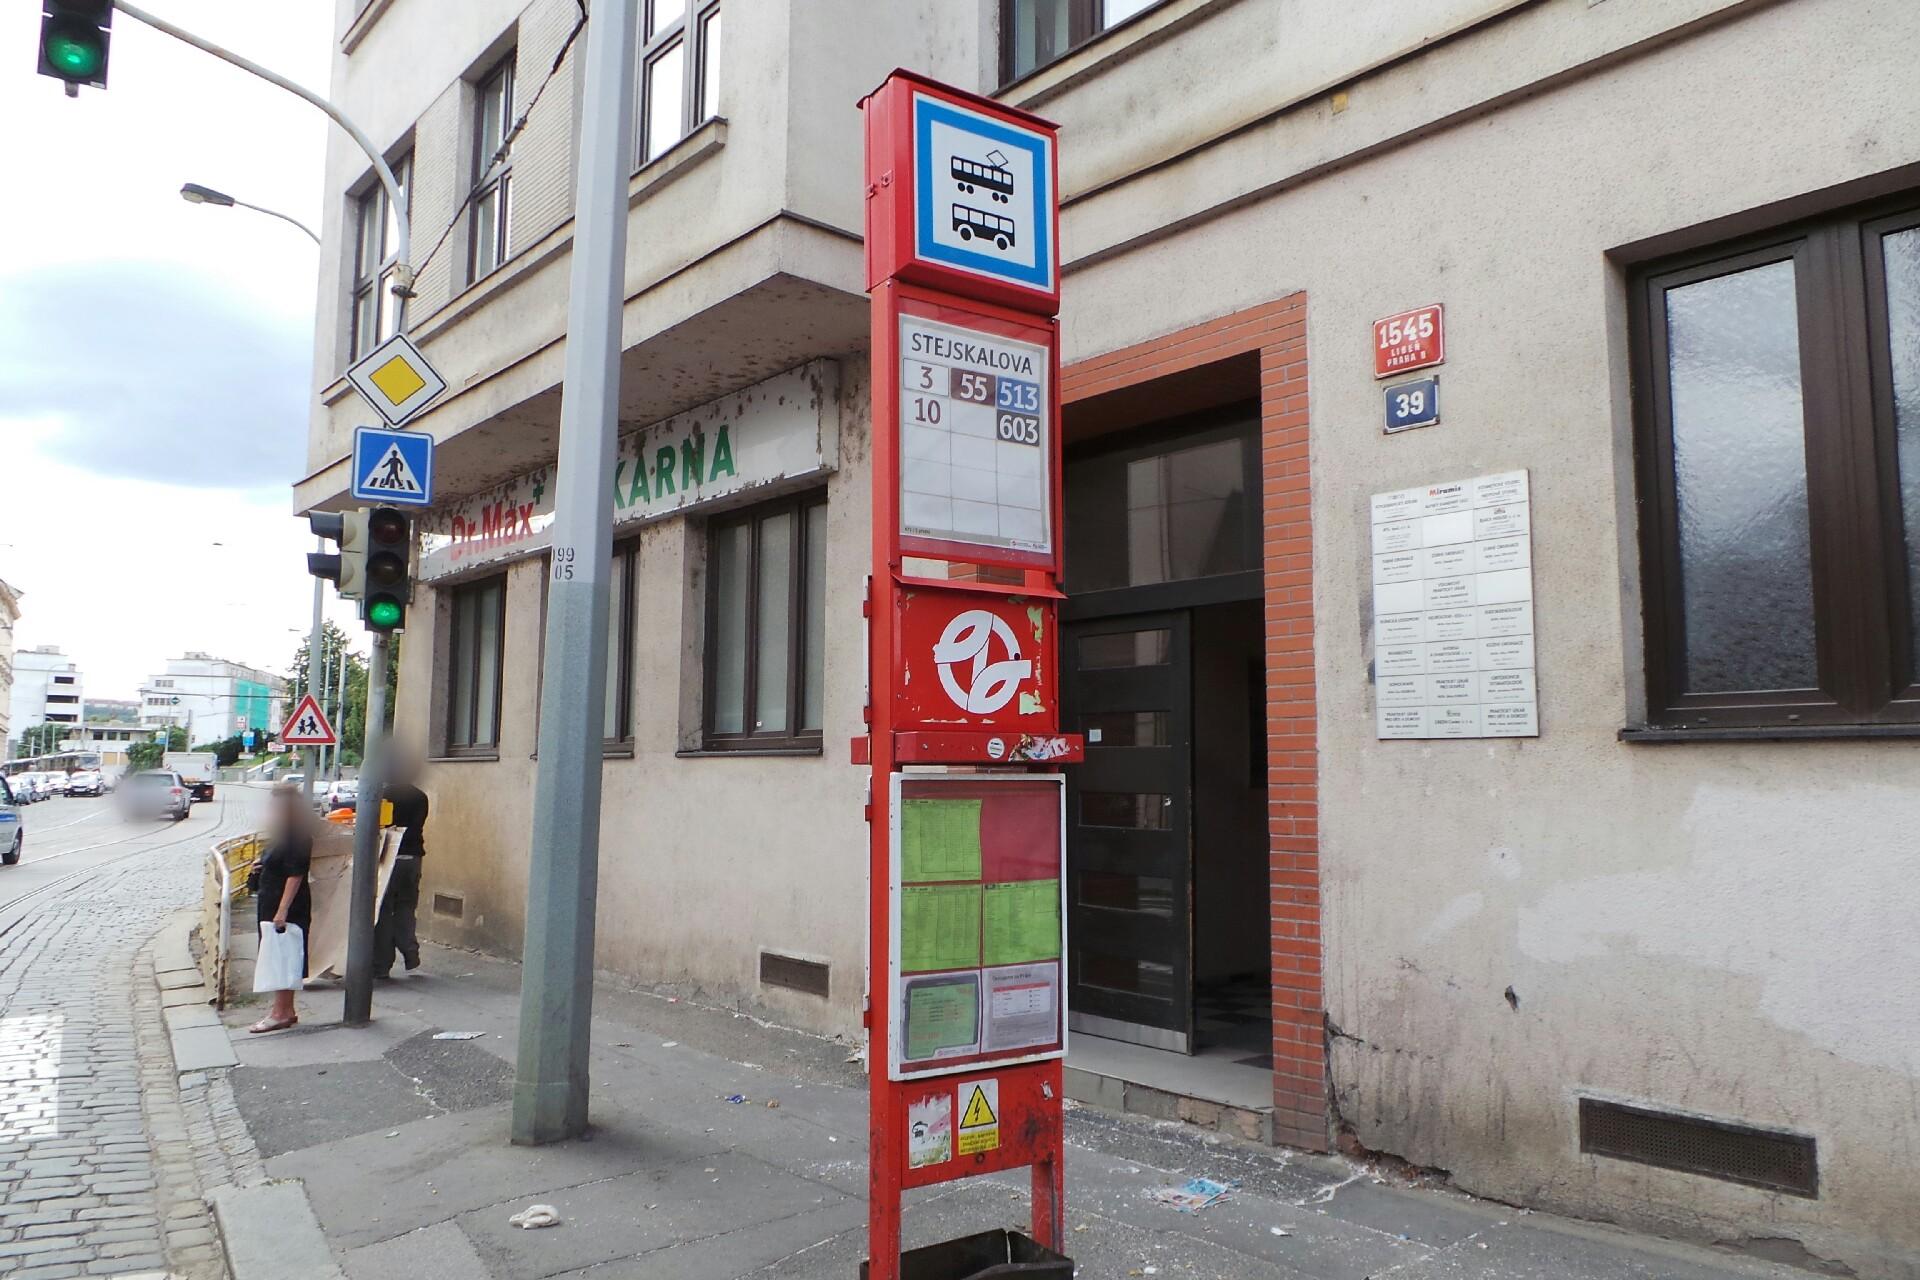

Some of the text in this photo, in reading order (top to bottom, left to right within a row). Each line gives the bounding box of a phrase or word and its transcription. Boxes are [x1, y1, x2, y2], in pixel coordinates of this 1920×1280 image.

[1380, 313, 1434, 349] 1545
[911, 333, 1033, 375] STEJSKALOVA
[1387, 352, 1416, 367] PRAHA
[919, 365, 1038, 411] 3 55 513
[1395, 390, 1424, 418] 39
[914, 397, 1039, 444] 10 603
